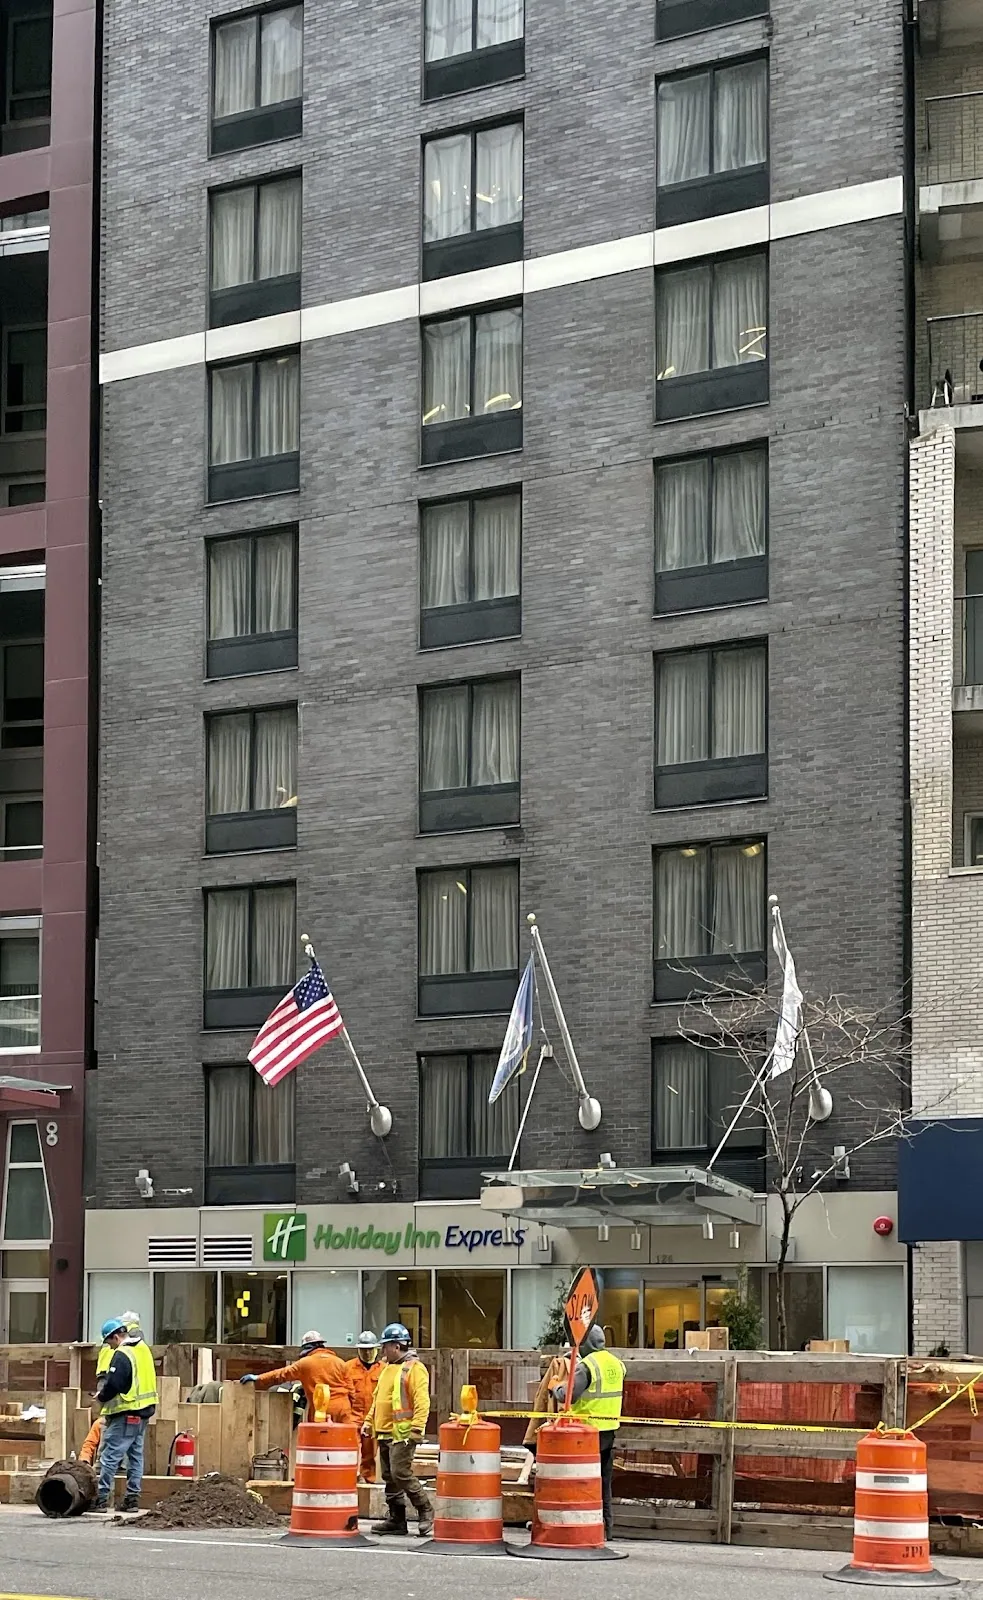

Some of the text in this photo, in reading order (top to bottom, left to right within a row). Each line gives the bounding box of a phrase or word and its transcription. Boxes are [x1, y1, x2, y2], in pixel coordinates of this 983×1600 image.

[46, 1121, 59, 1147] 8
[313, 1223, 402, 1256] Holiday
[404, 1221, 441, 1249] Inn
